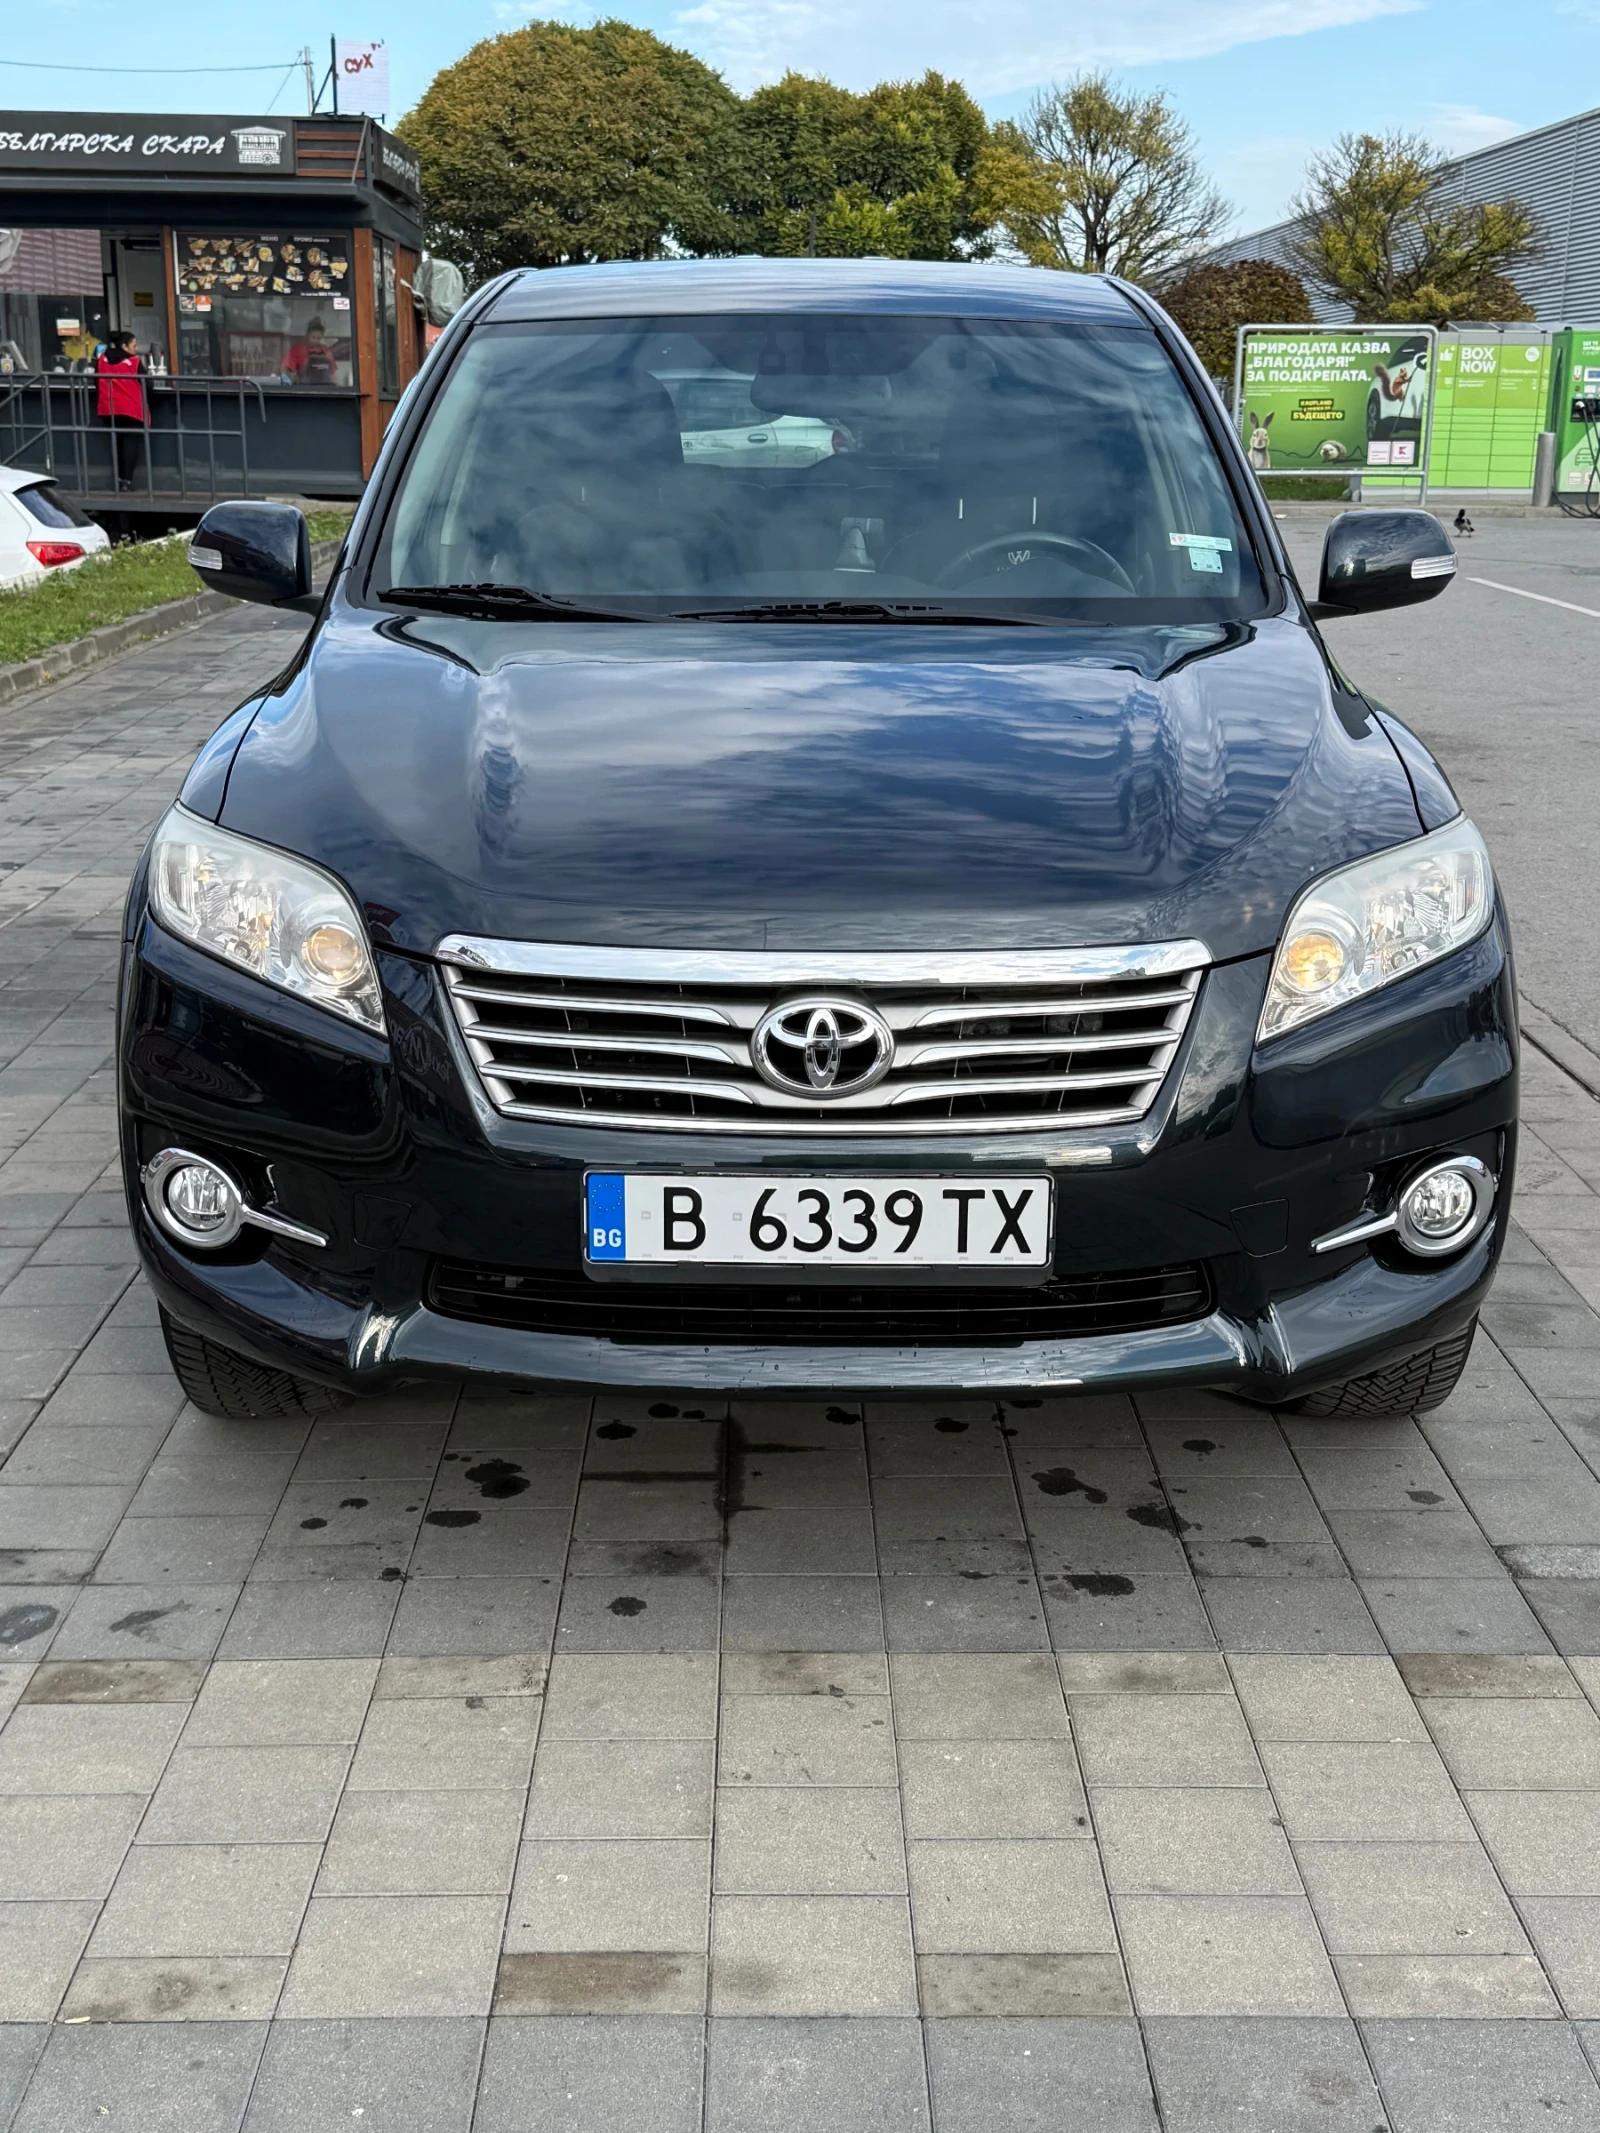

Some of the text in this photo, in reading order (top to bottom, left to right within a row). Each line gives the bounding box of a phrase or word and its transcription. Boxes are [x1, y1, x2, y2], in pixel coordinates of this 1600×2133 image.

[141, 134, 226, 155] СКАРА
[1247, 342, 1390, 355] ПРИРОДАТА КАЗВА
[1461, 347, 1495, 360] BOX
[1460, 360, 1496, 373] NOW
[1246, 370, 1371, 383] ЗА ПОДКРЕПАТА.
[1293, 412, 1343, 420] БЪДЕЩЕТО
[663, 1186, 1035, 1254] B 6339 TX
[593, 1227, 622, 1248] BG
